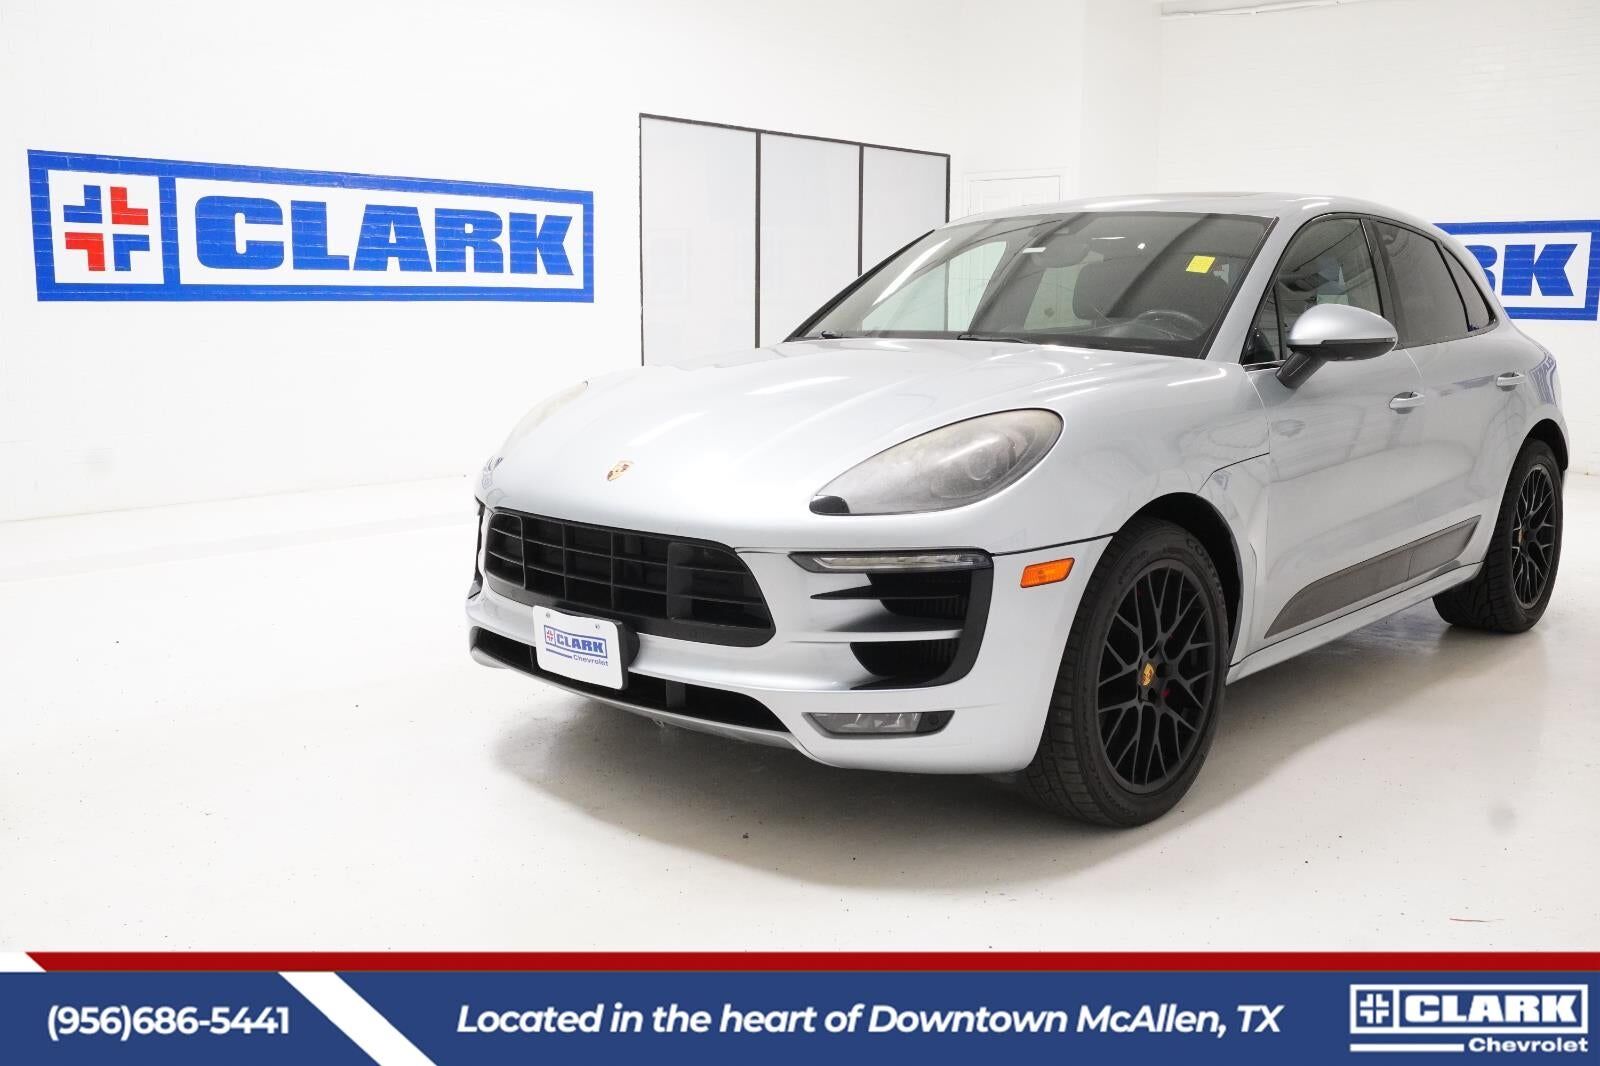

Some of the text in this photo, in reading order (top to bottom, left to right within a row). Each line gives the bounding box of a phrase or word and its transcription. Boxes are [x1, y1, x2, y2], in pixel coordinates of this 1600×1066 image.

[194, 195, 575, 276] CLARK
[556, 633, 604, 654] CLARK
[573, 654, 609, 667] Chevrolet
